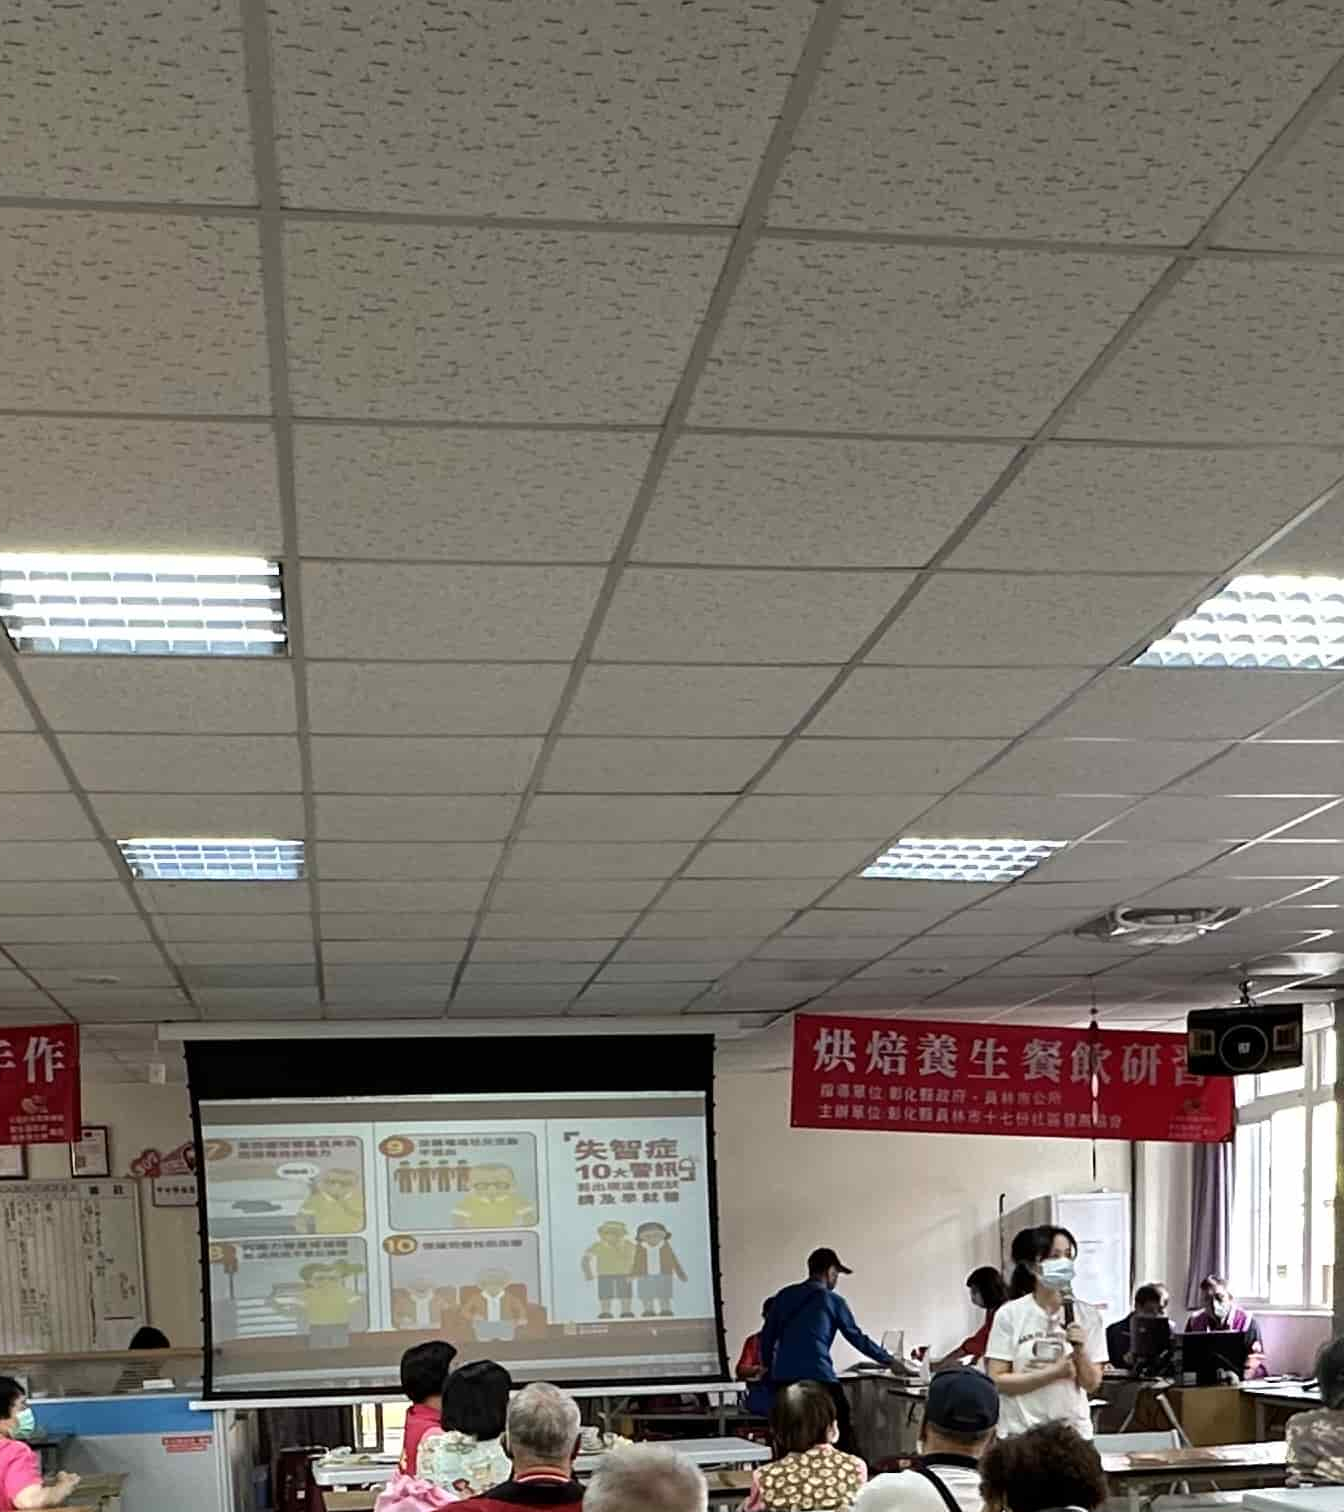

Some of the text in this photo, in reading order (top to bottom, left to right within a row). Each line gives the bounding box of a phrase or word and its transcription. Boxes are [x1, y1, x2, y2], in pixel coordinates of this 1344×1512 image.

[574, 1138, 680, 1161] 失智症
[386, 1238, 414, 1253] 10
